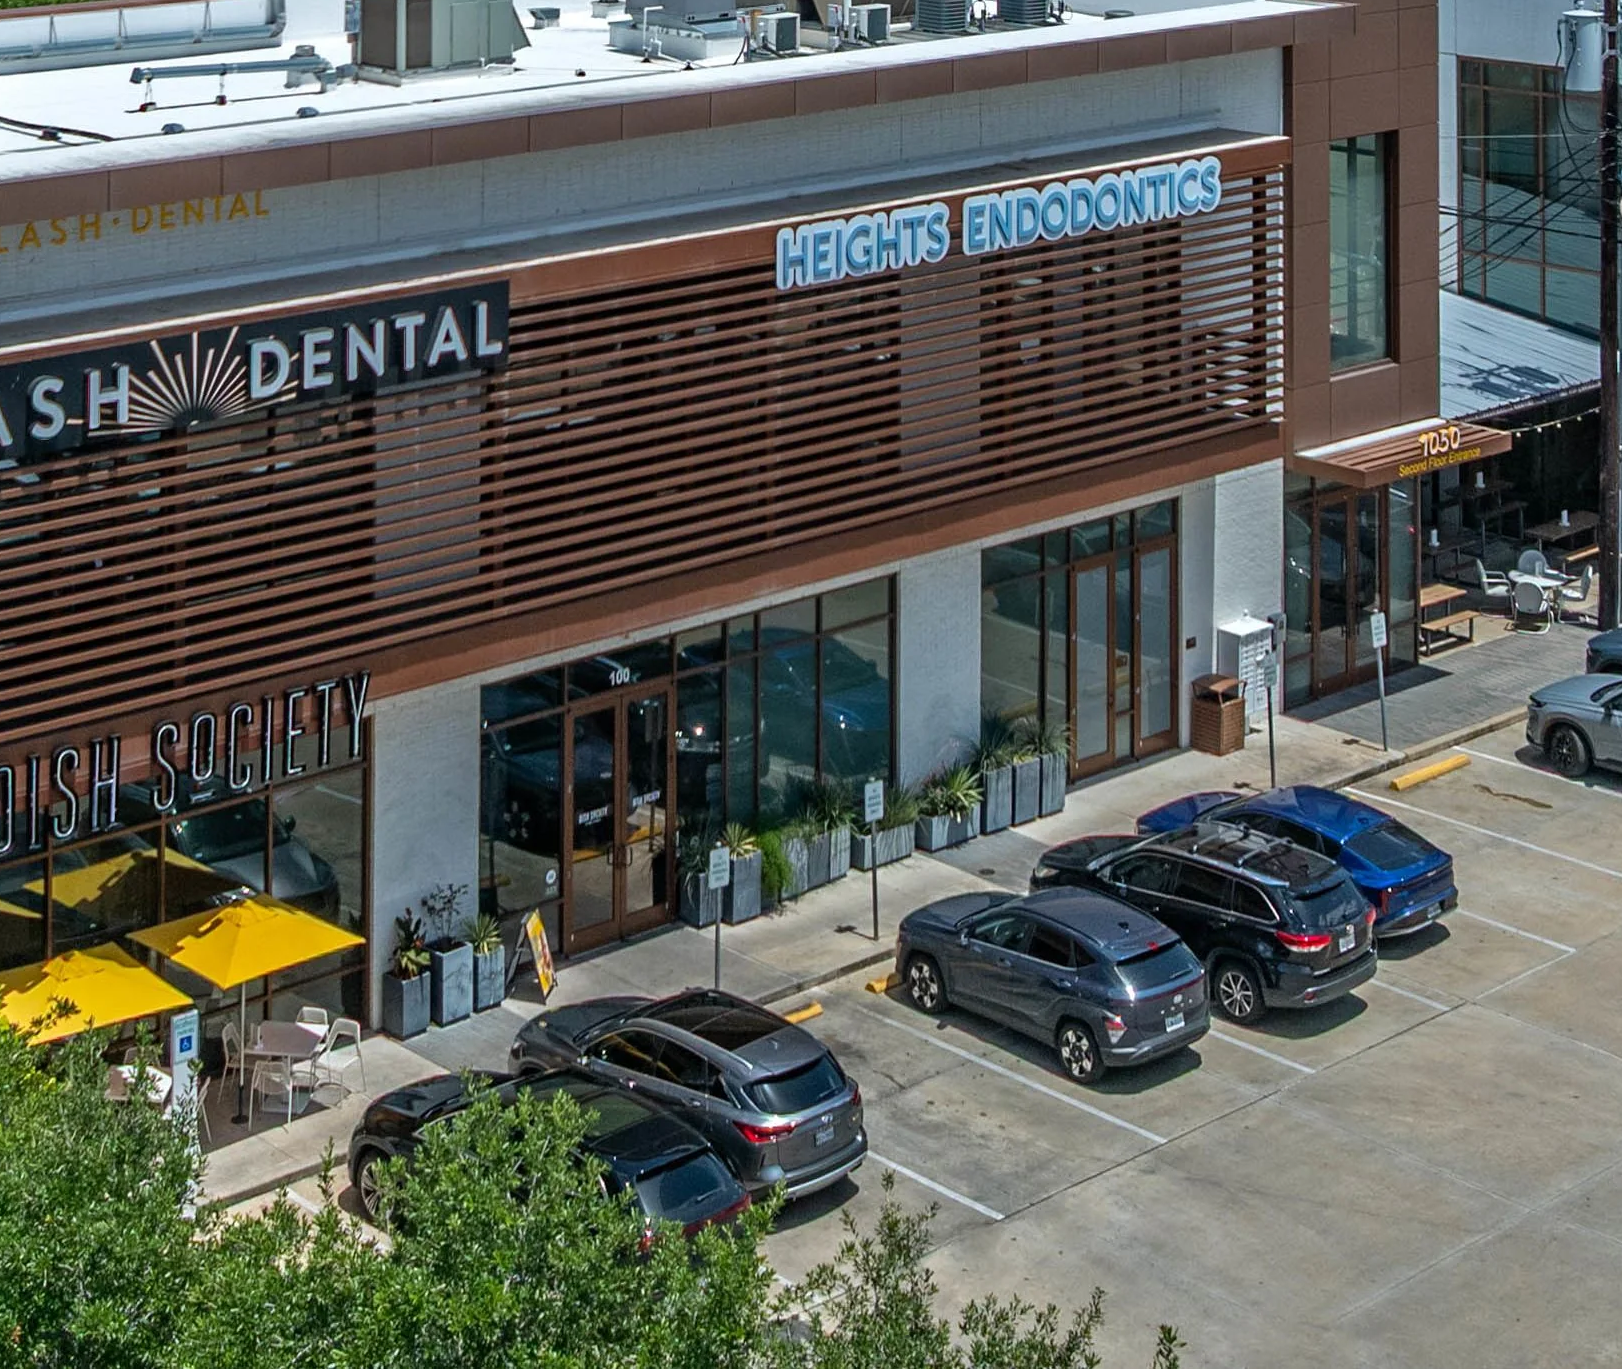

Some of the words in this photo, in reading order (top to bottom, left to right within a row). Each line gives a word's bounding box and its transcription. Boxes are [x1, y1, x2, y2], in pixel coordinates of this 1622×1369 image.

[131, 188, 271, 234] DENTAL
[777, 203, 950, 290] HEIGHTS
[962, 157, 1221, 255] ENDODONTICS
[246, 299, 503, 401] DENTAL
[1399, 459, 1427, 477] Second
[1429, 455, 1447, 468] Floor
[1448, 447, 1481, 464] Entrance
[1418, 426, 1460, 457] 1050
[609, 667, 630, 687] 100
[151, 669, 371, 813] SOCIETY
